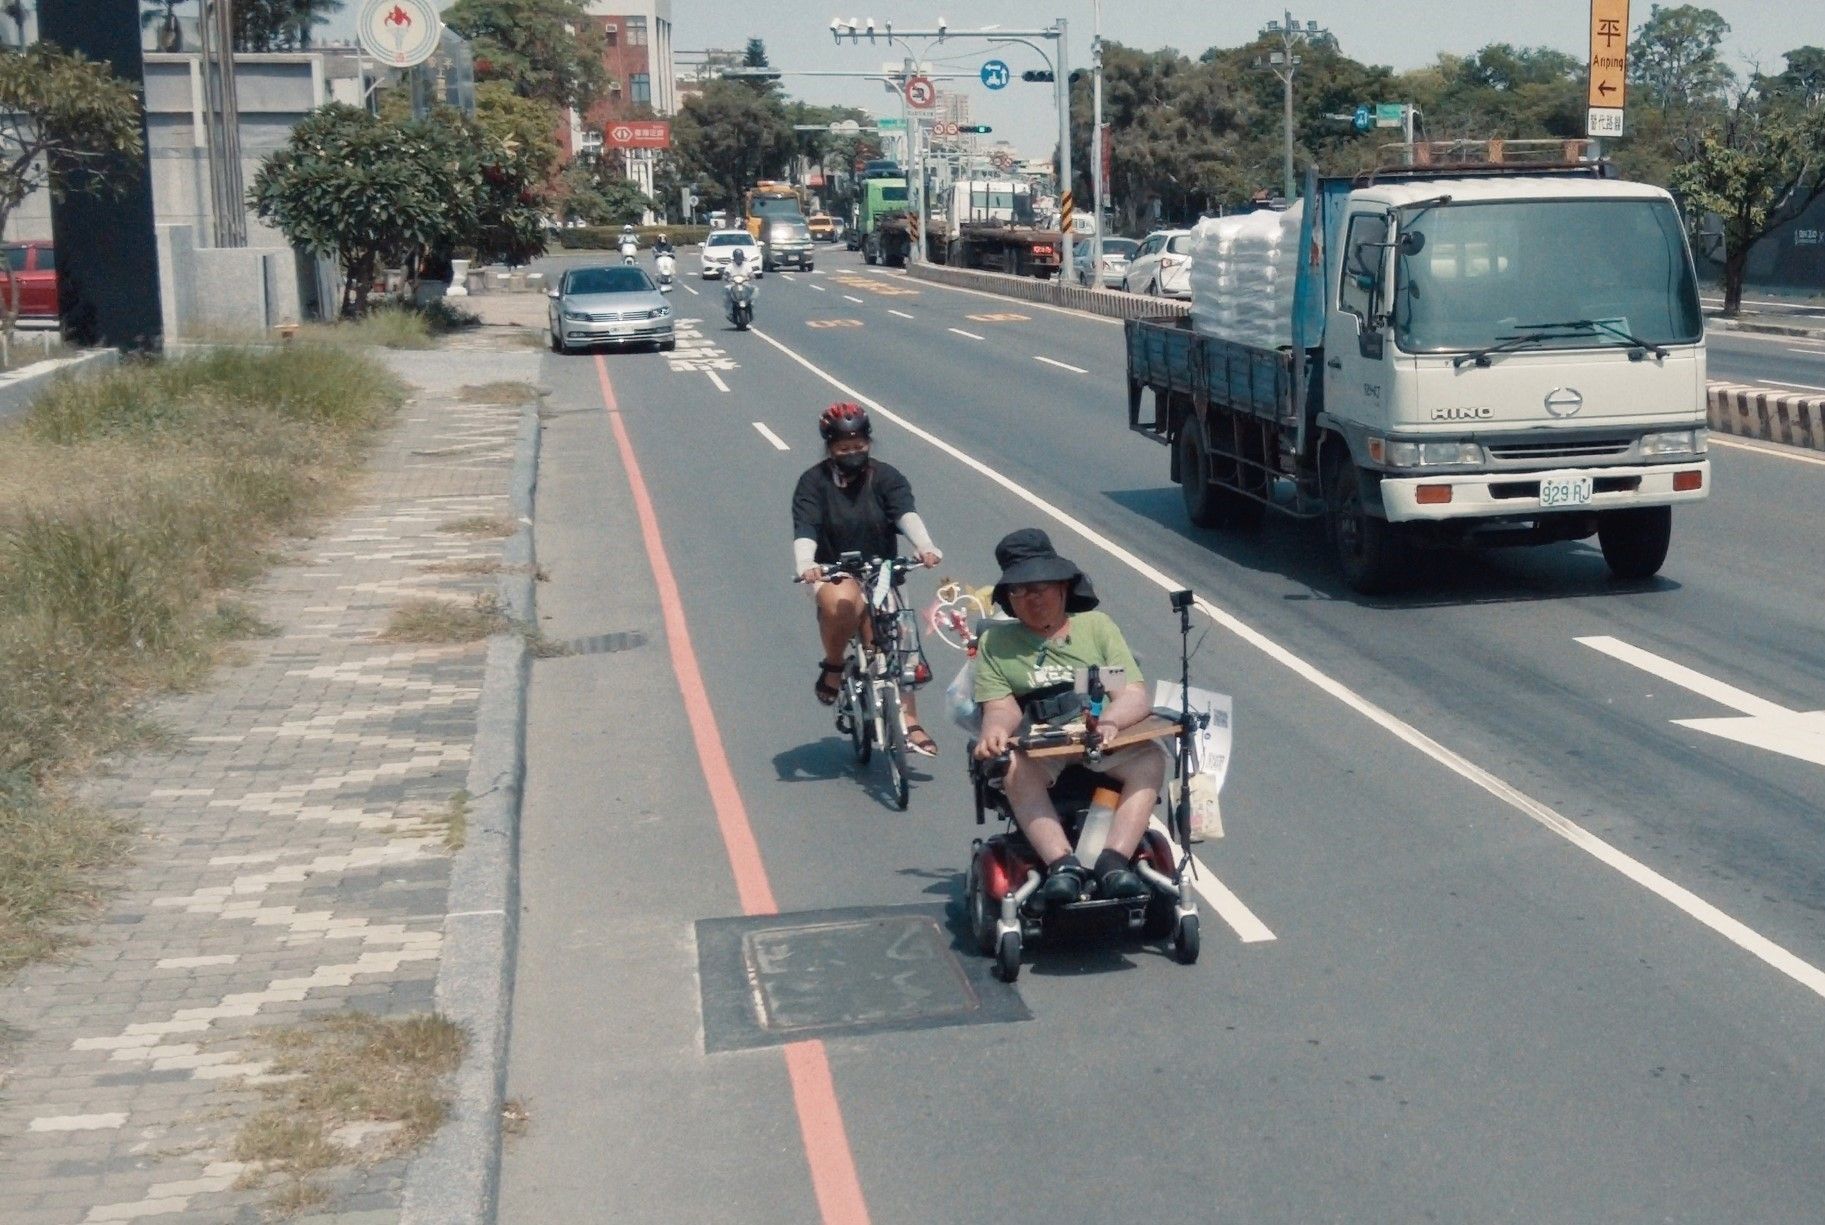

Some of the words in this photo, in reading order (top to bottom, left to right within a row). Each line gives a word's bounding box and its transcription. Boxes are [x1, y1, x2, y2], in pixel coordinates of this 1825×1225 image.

[1597, 19, 1621, 48] 平
[1593, 54, 1624, 71] Anping
[1431, 407, 1496, 421] HINO
[1542, 485, 1569, 505] 929
